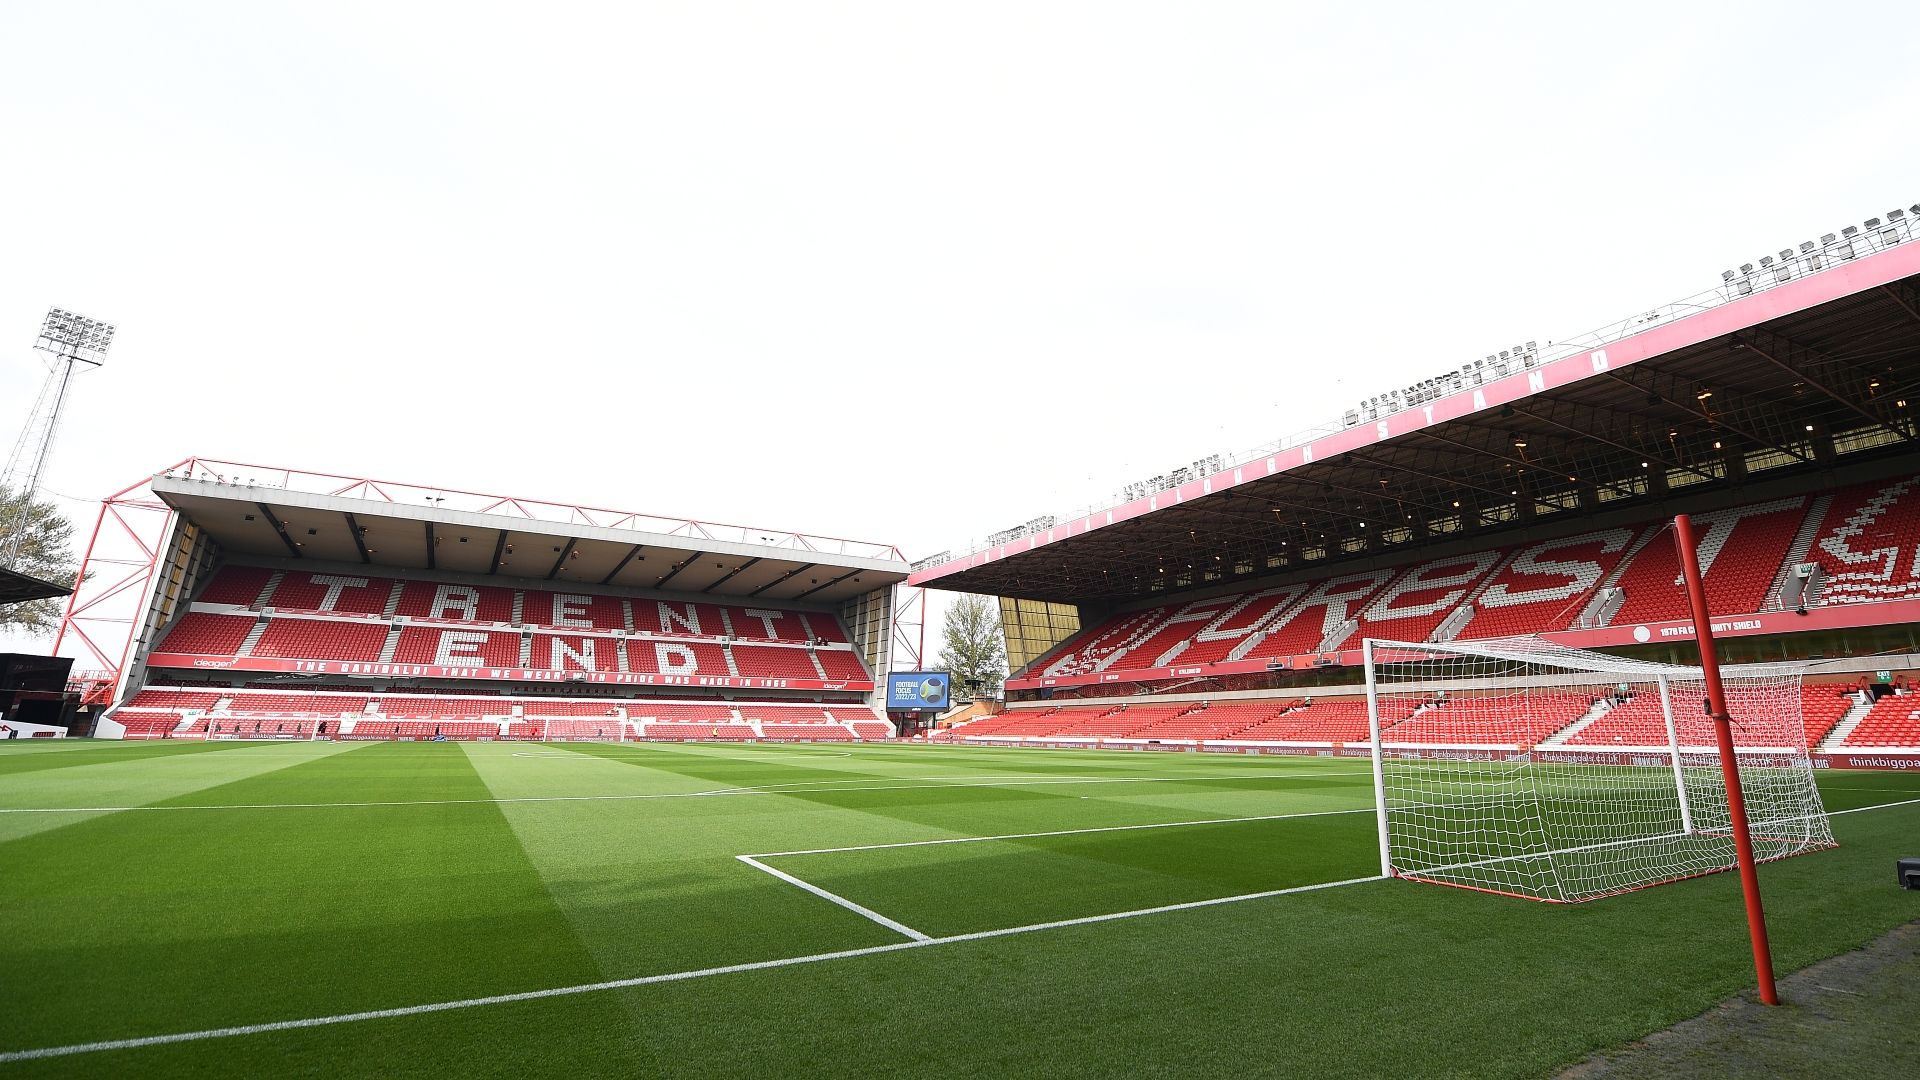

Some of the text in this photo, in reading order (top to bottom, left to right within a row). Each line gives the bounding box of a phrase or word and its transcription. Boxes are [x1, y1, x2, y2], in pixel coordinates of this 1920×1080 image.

[1150, 444, 1313, 510] CLOUGH
[1376, 350, 1609, 440] STAND
[310, 574, 783, 640] TRENT
[1678, 626, 1688, 635] FA
[1733, 620, 1761, 630] SHIELD
[434, 630, 699, 676] END
[296, 661, 327, 672] THE
[340, 663, 428, 675] GARIBALDI
[441, 667, 478, 677] THAT
[491, 669, 511, 678] WE
[523, 670, 561, 680] WEAR
[573, 673, 606, 682] WITH
[617, 675, 655, 683] PRIDE
[665, 676, 690, 684] WAS
[700, 677, 730, 685] MADE
[1815, 759, 1829, 769] BIG
